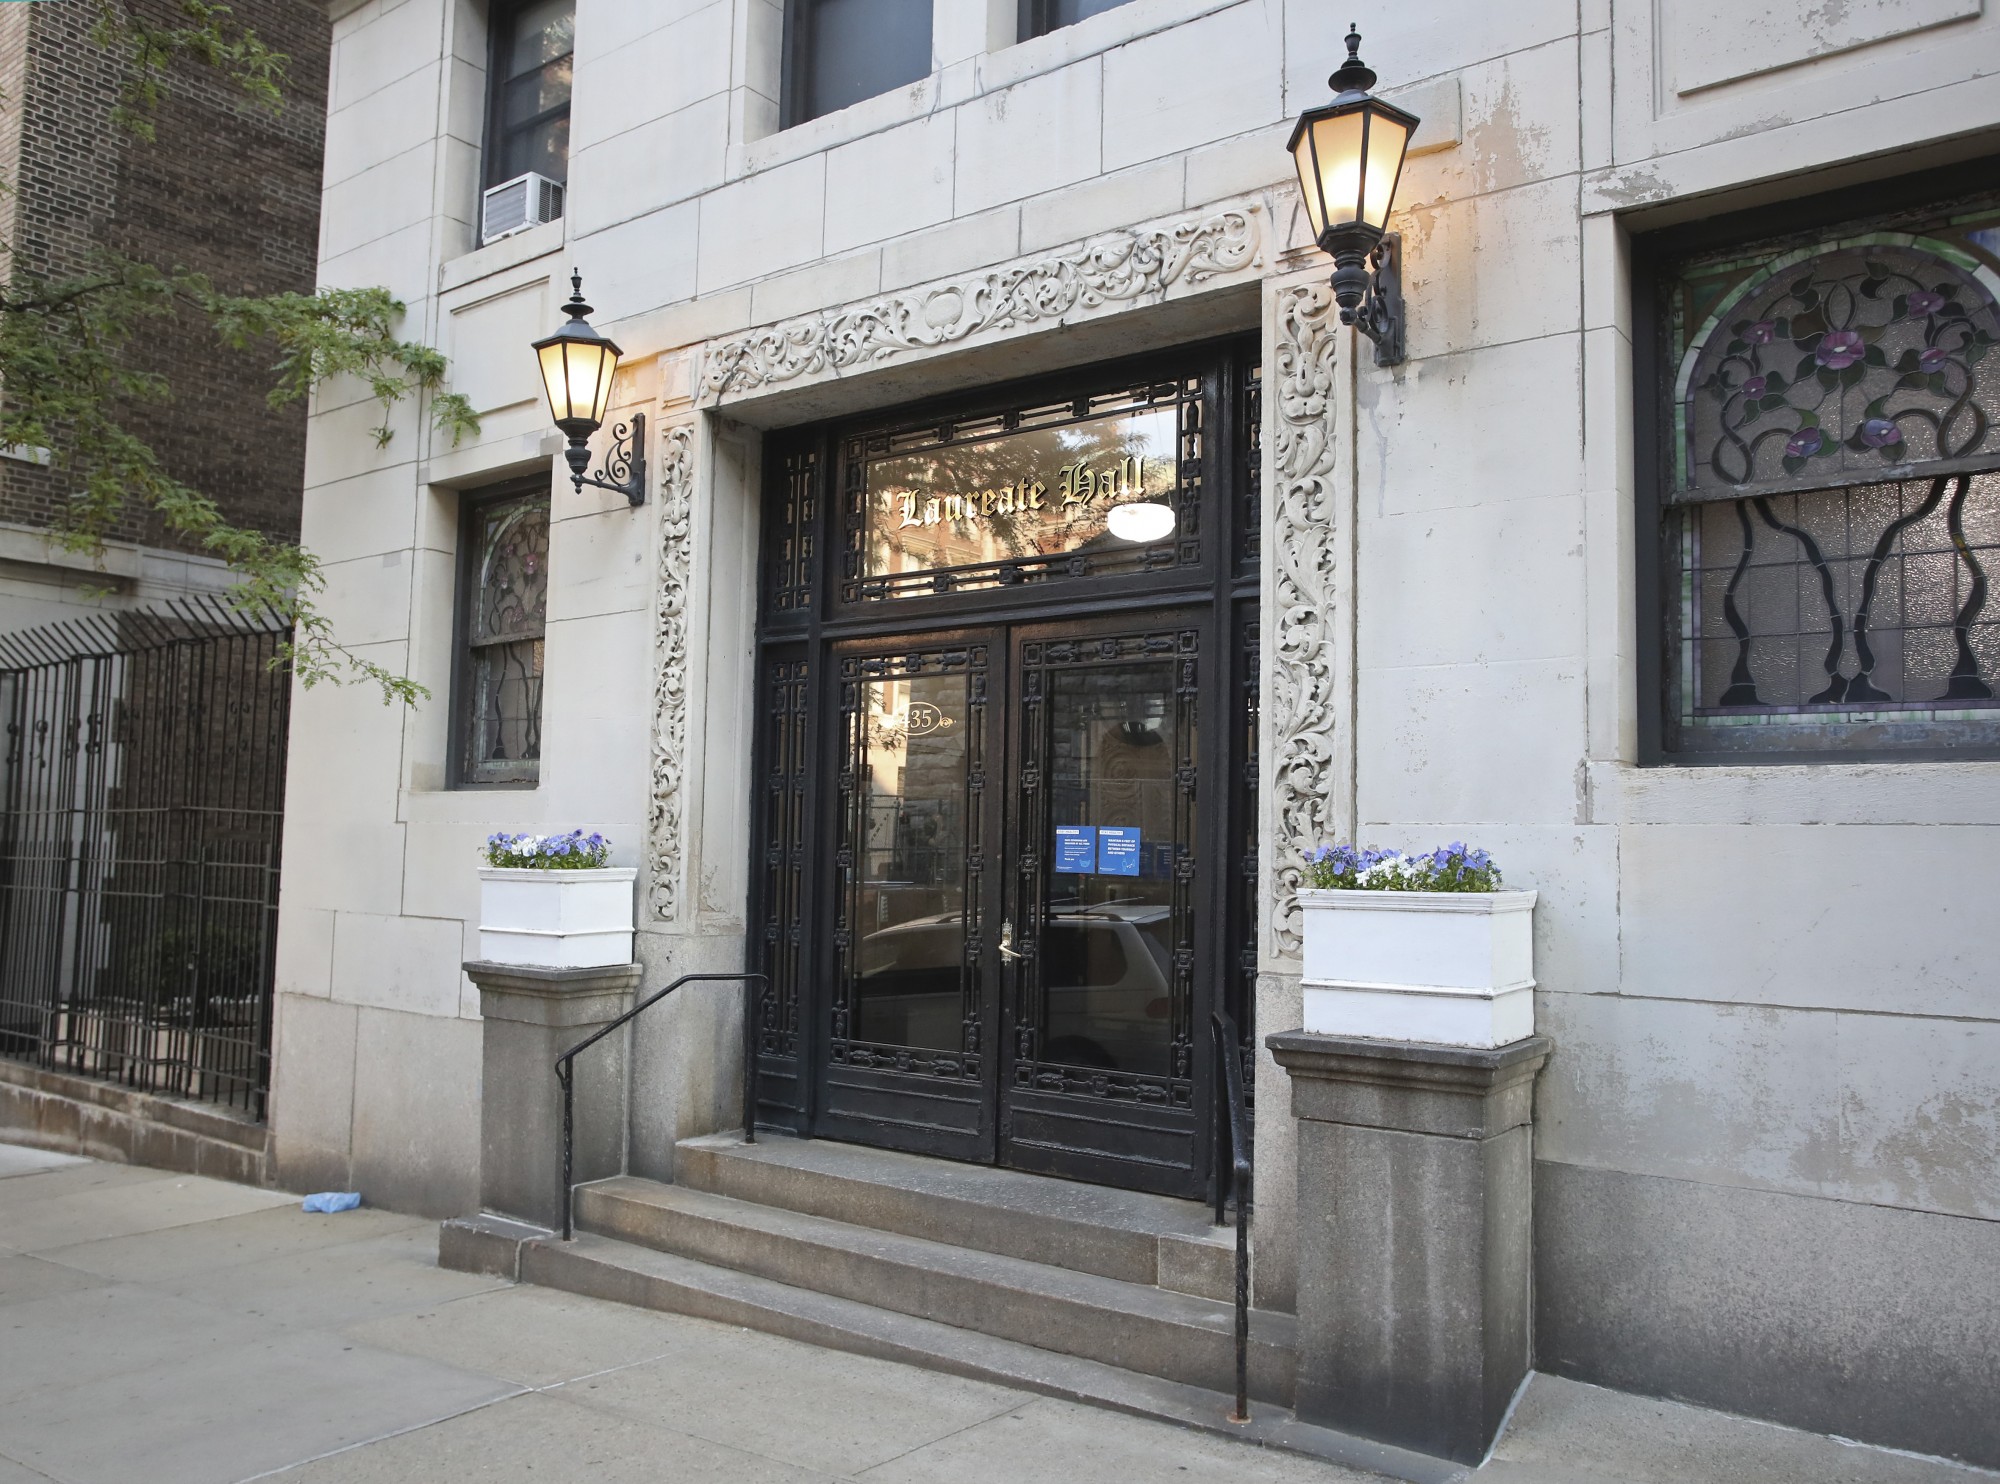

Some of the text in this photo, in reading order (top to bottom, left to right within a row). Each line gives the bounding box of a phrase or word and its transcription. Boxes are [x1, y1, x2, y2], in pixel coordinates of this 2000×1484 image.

[896, 454, 1145, 529] Laureate Hall
[901, 709, 932, 728] 435
